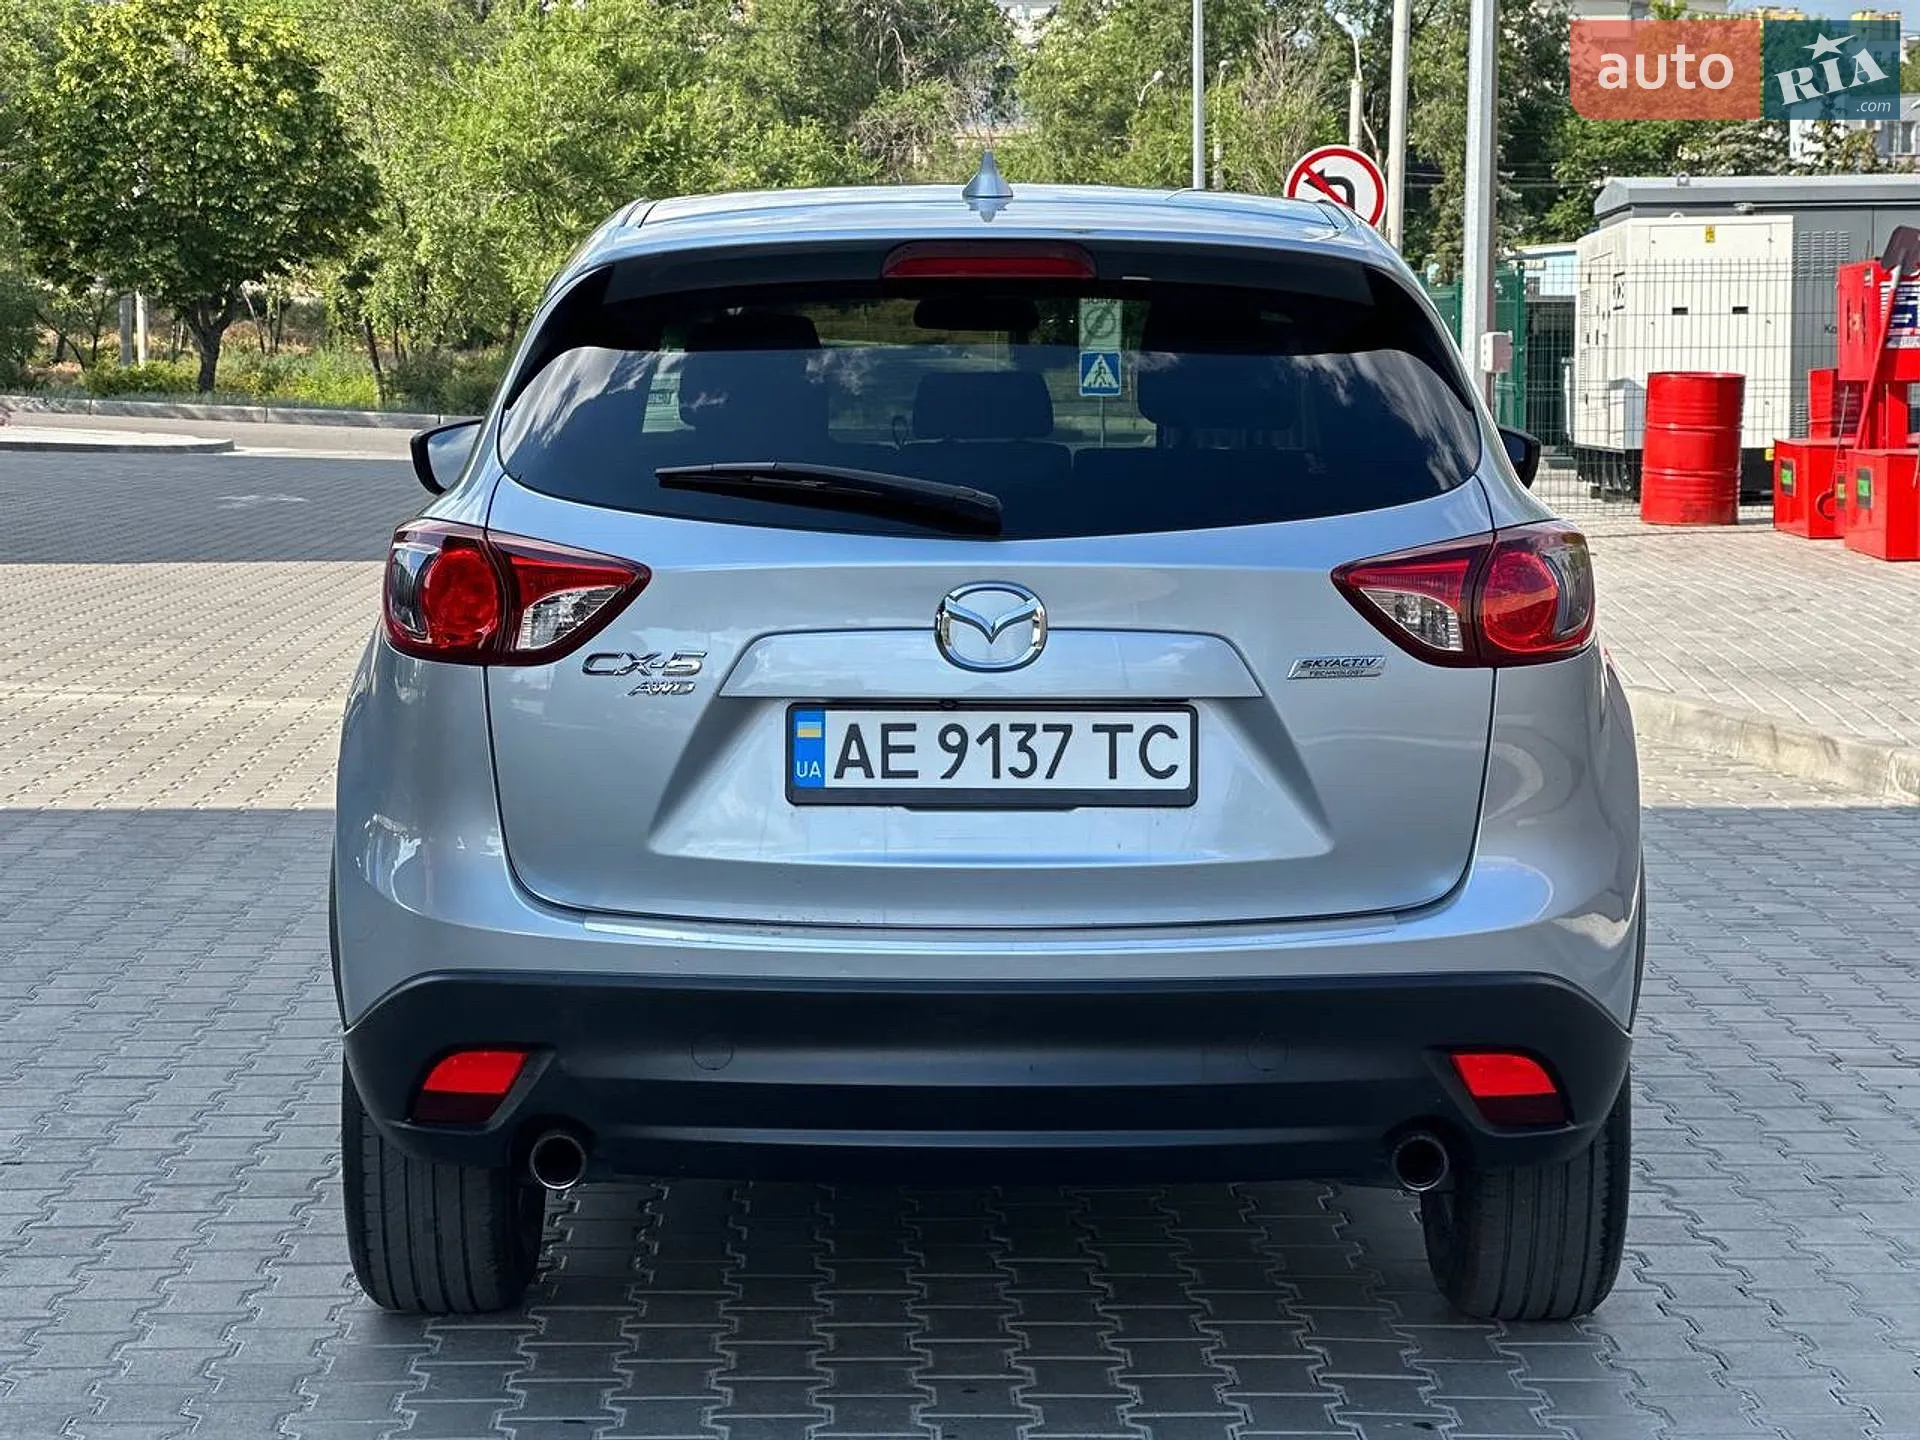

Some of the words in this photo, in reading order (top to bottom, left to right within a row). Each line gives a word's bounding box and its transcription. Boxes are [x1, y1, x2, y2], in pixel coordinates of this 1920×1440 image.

[582, 651, 707, 677] CX-5
[1300, 658, 1377, 669] SKYACTIV
[627, 680, 696, 696] AWD
[833, 723, 919, 779] AE
[937, 723, 1073, 780] 9137
[1092, 723, 1179, 780] TC
[796, 761, 822, 778] UA
